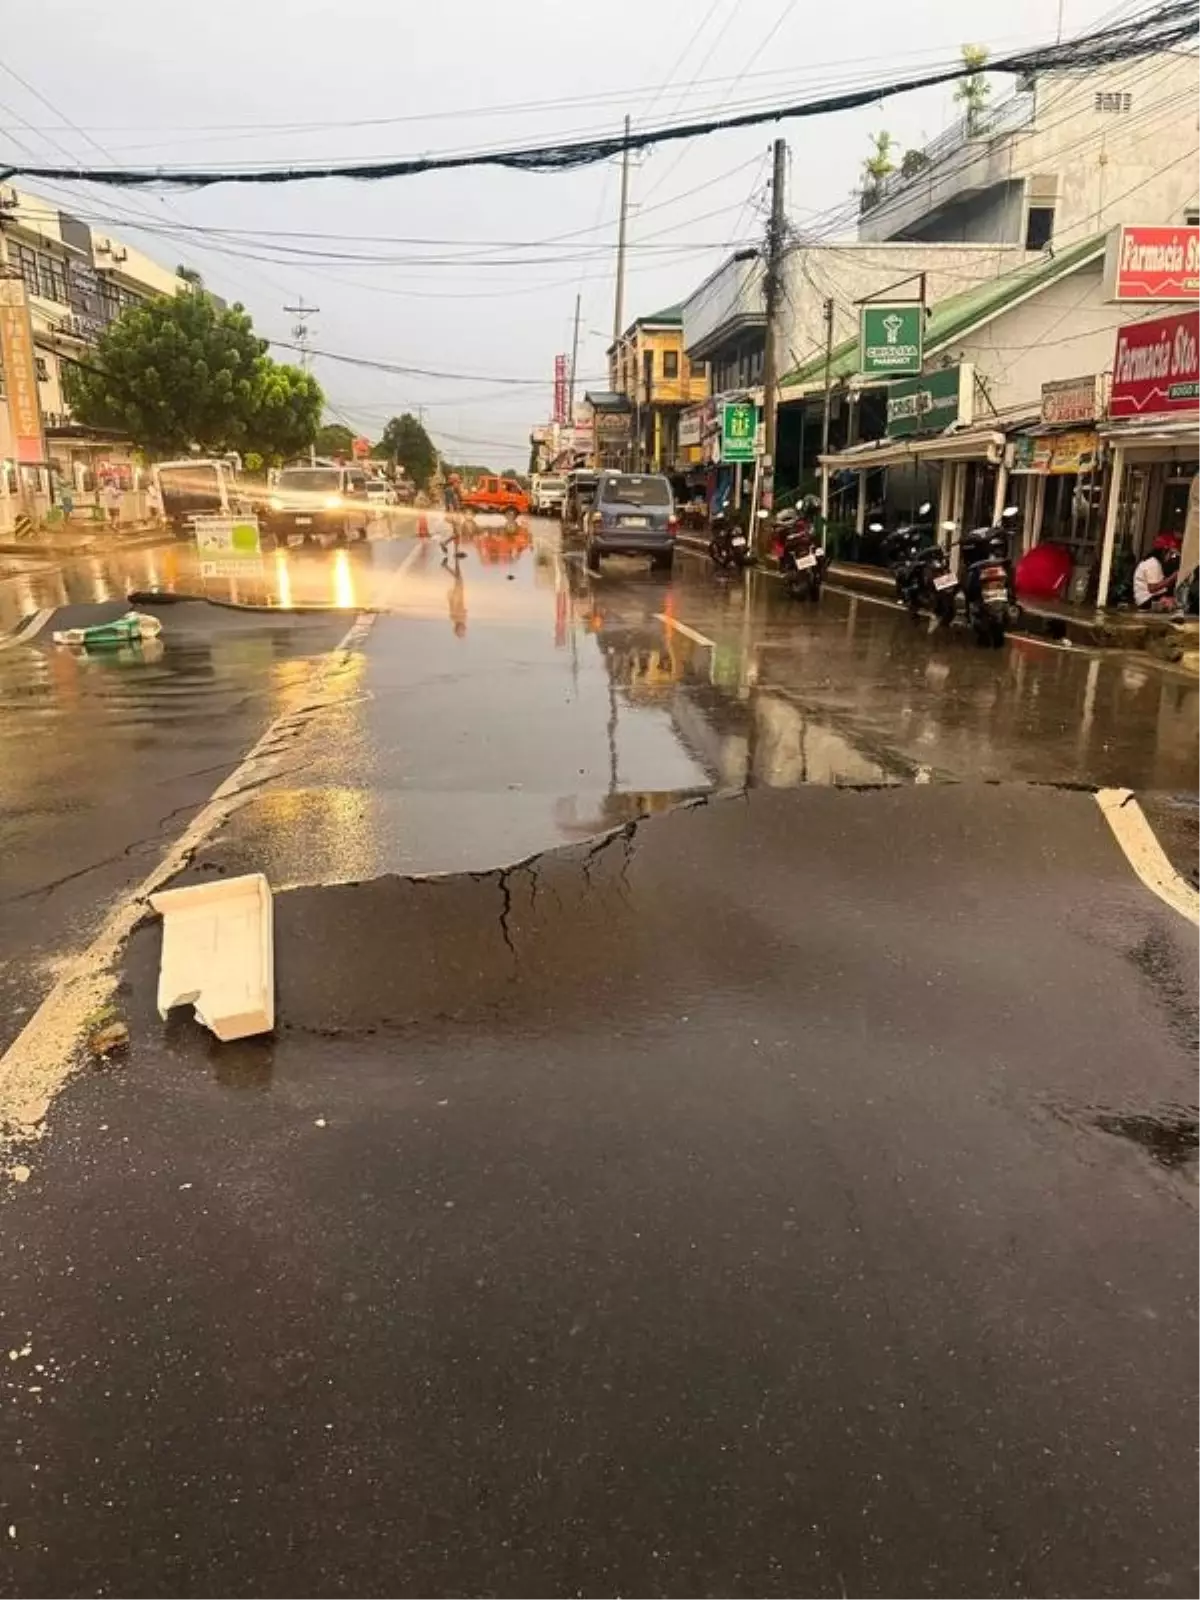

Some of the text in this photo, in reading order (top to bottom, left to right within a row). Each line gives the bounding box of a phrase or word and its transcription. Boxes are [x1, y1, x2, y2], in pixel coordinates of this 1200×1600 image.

[1121, 235, 1184, 272] Farmacia
[873, 357, 911, 366] PHARMACY
[1115, 329, 1171, 384] Farmacia
